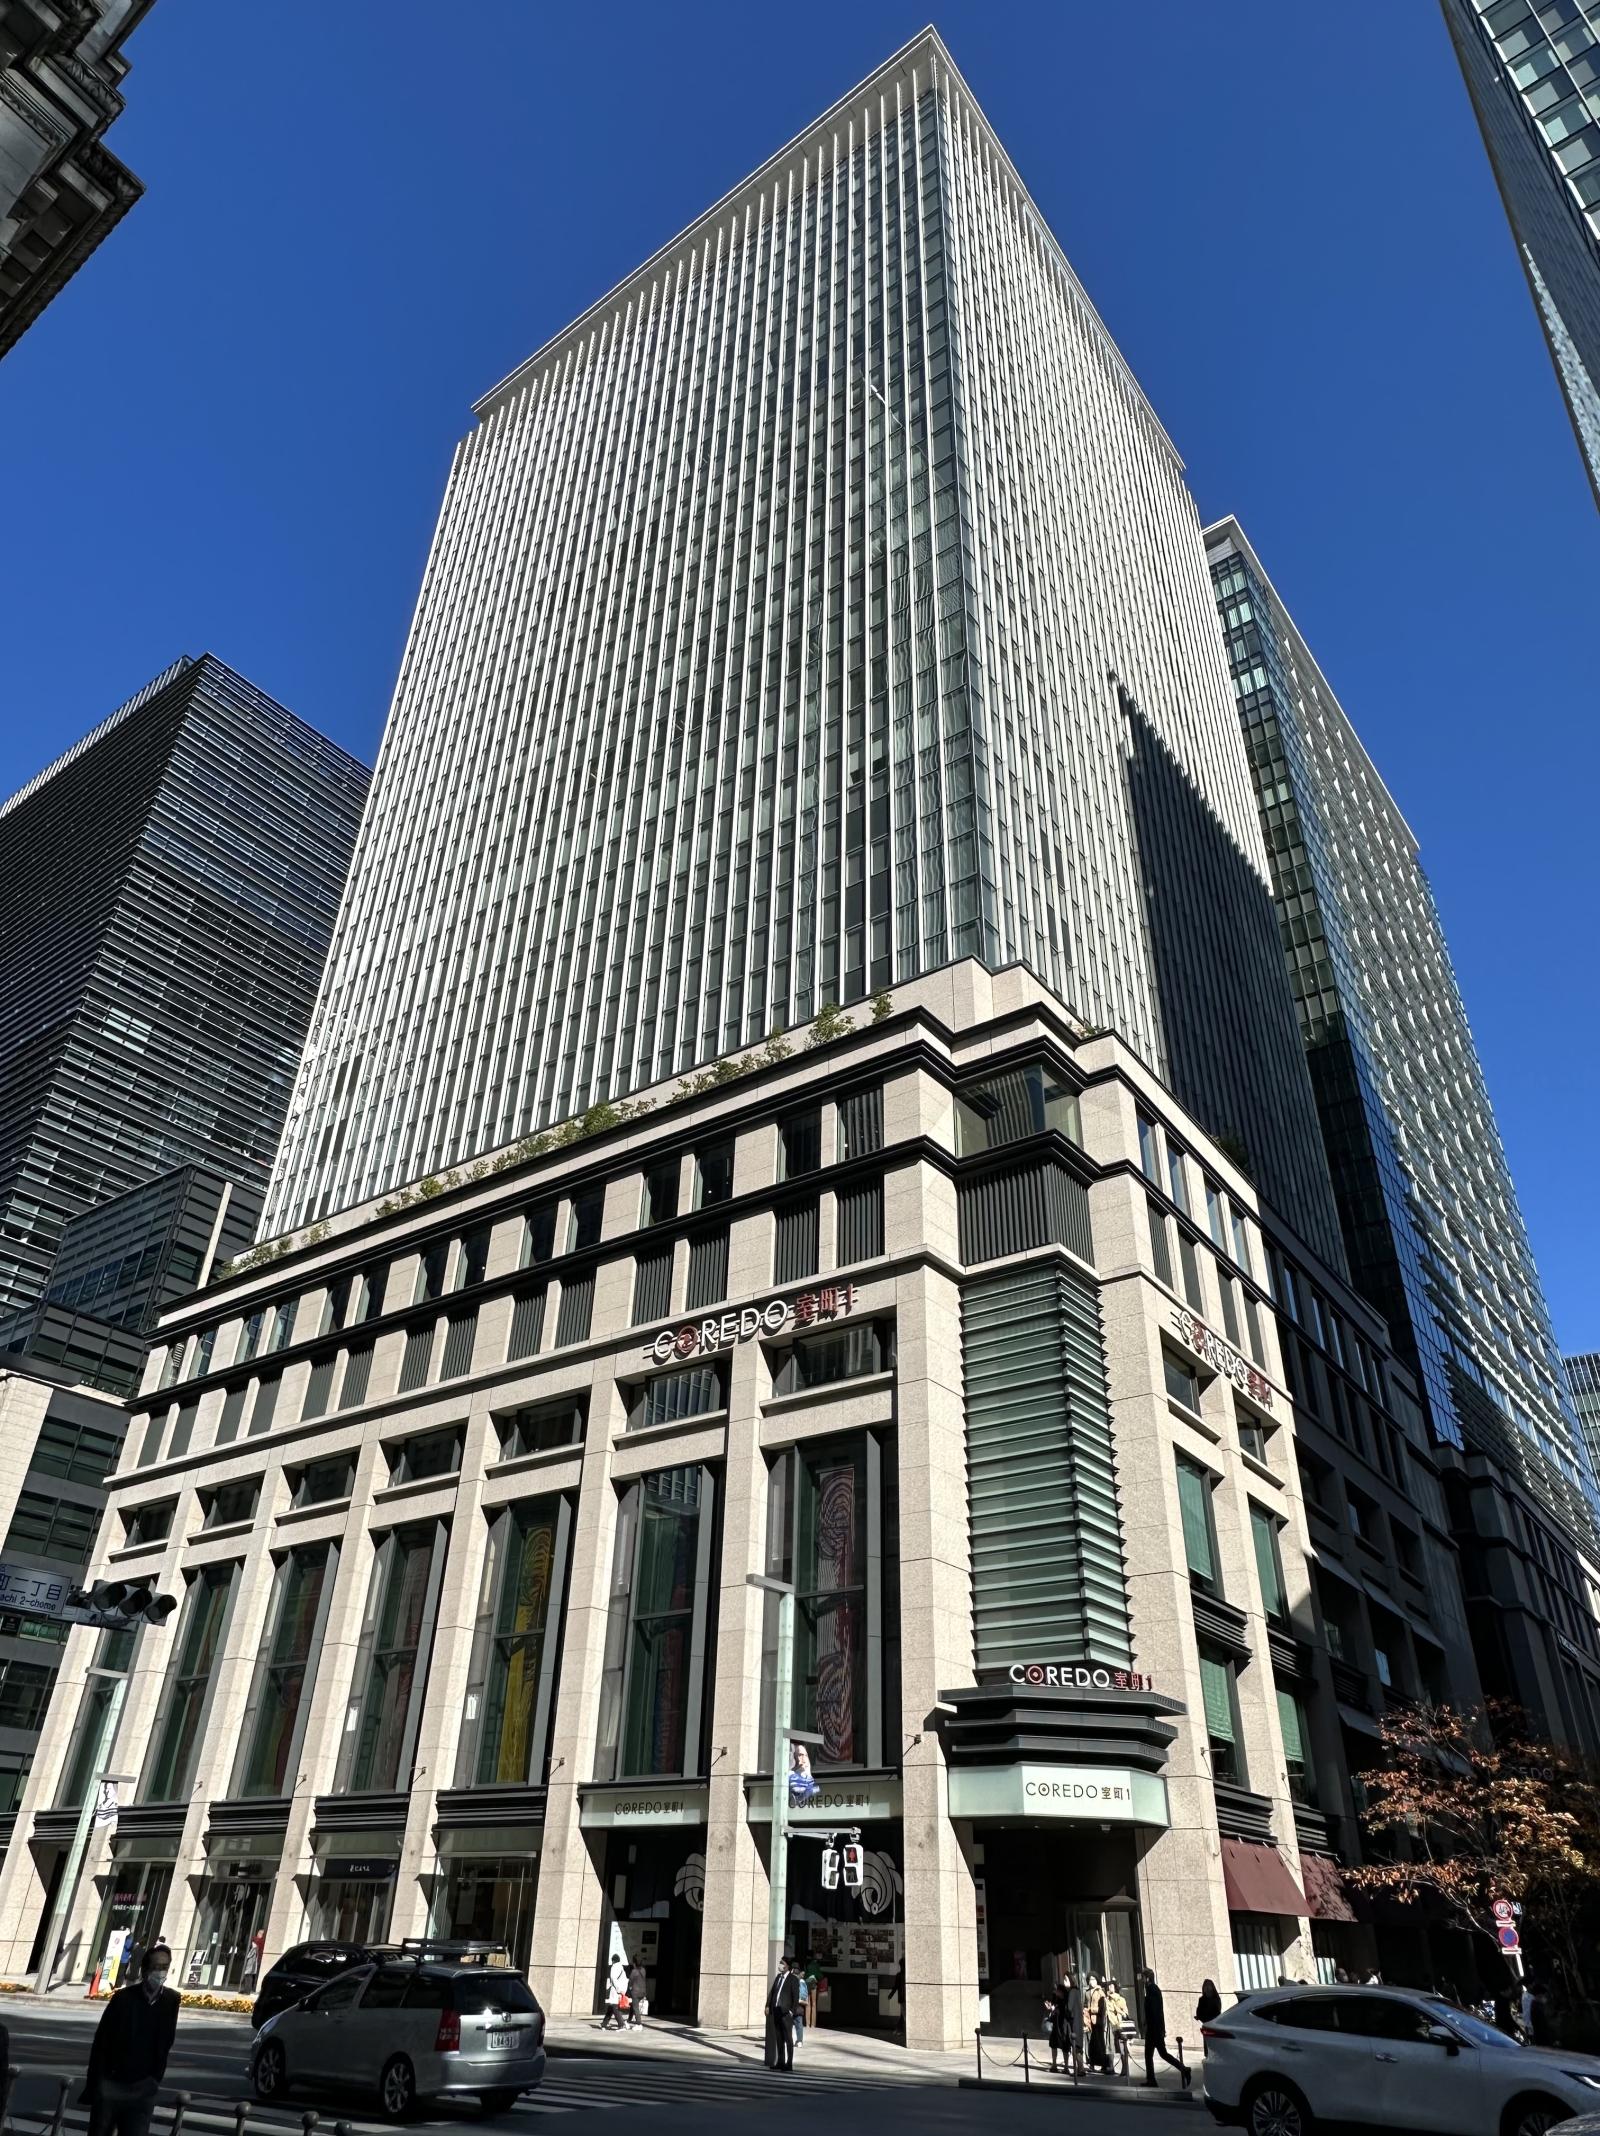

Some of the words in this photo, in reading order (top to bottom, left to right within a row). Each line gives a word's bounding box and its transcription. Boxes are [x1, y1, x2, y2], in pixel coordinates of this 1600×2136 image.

[654, 1300, 789, 1359] COREDO
[1179, 1310, 1249, 1388] COREDO
[19, 1596, 56, 1611] 2-chome
[1009, 1664, 1110, 1688] COREDO
[1025, 1782, 1098, 1799] COREDO
[615, 1801, 662, 1816] COREDO
